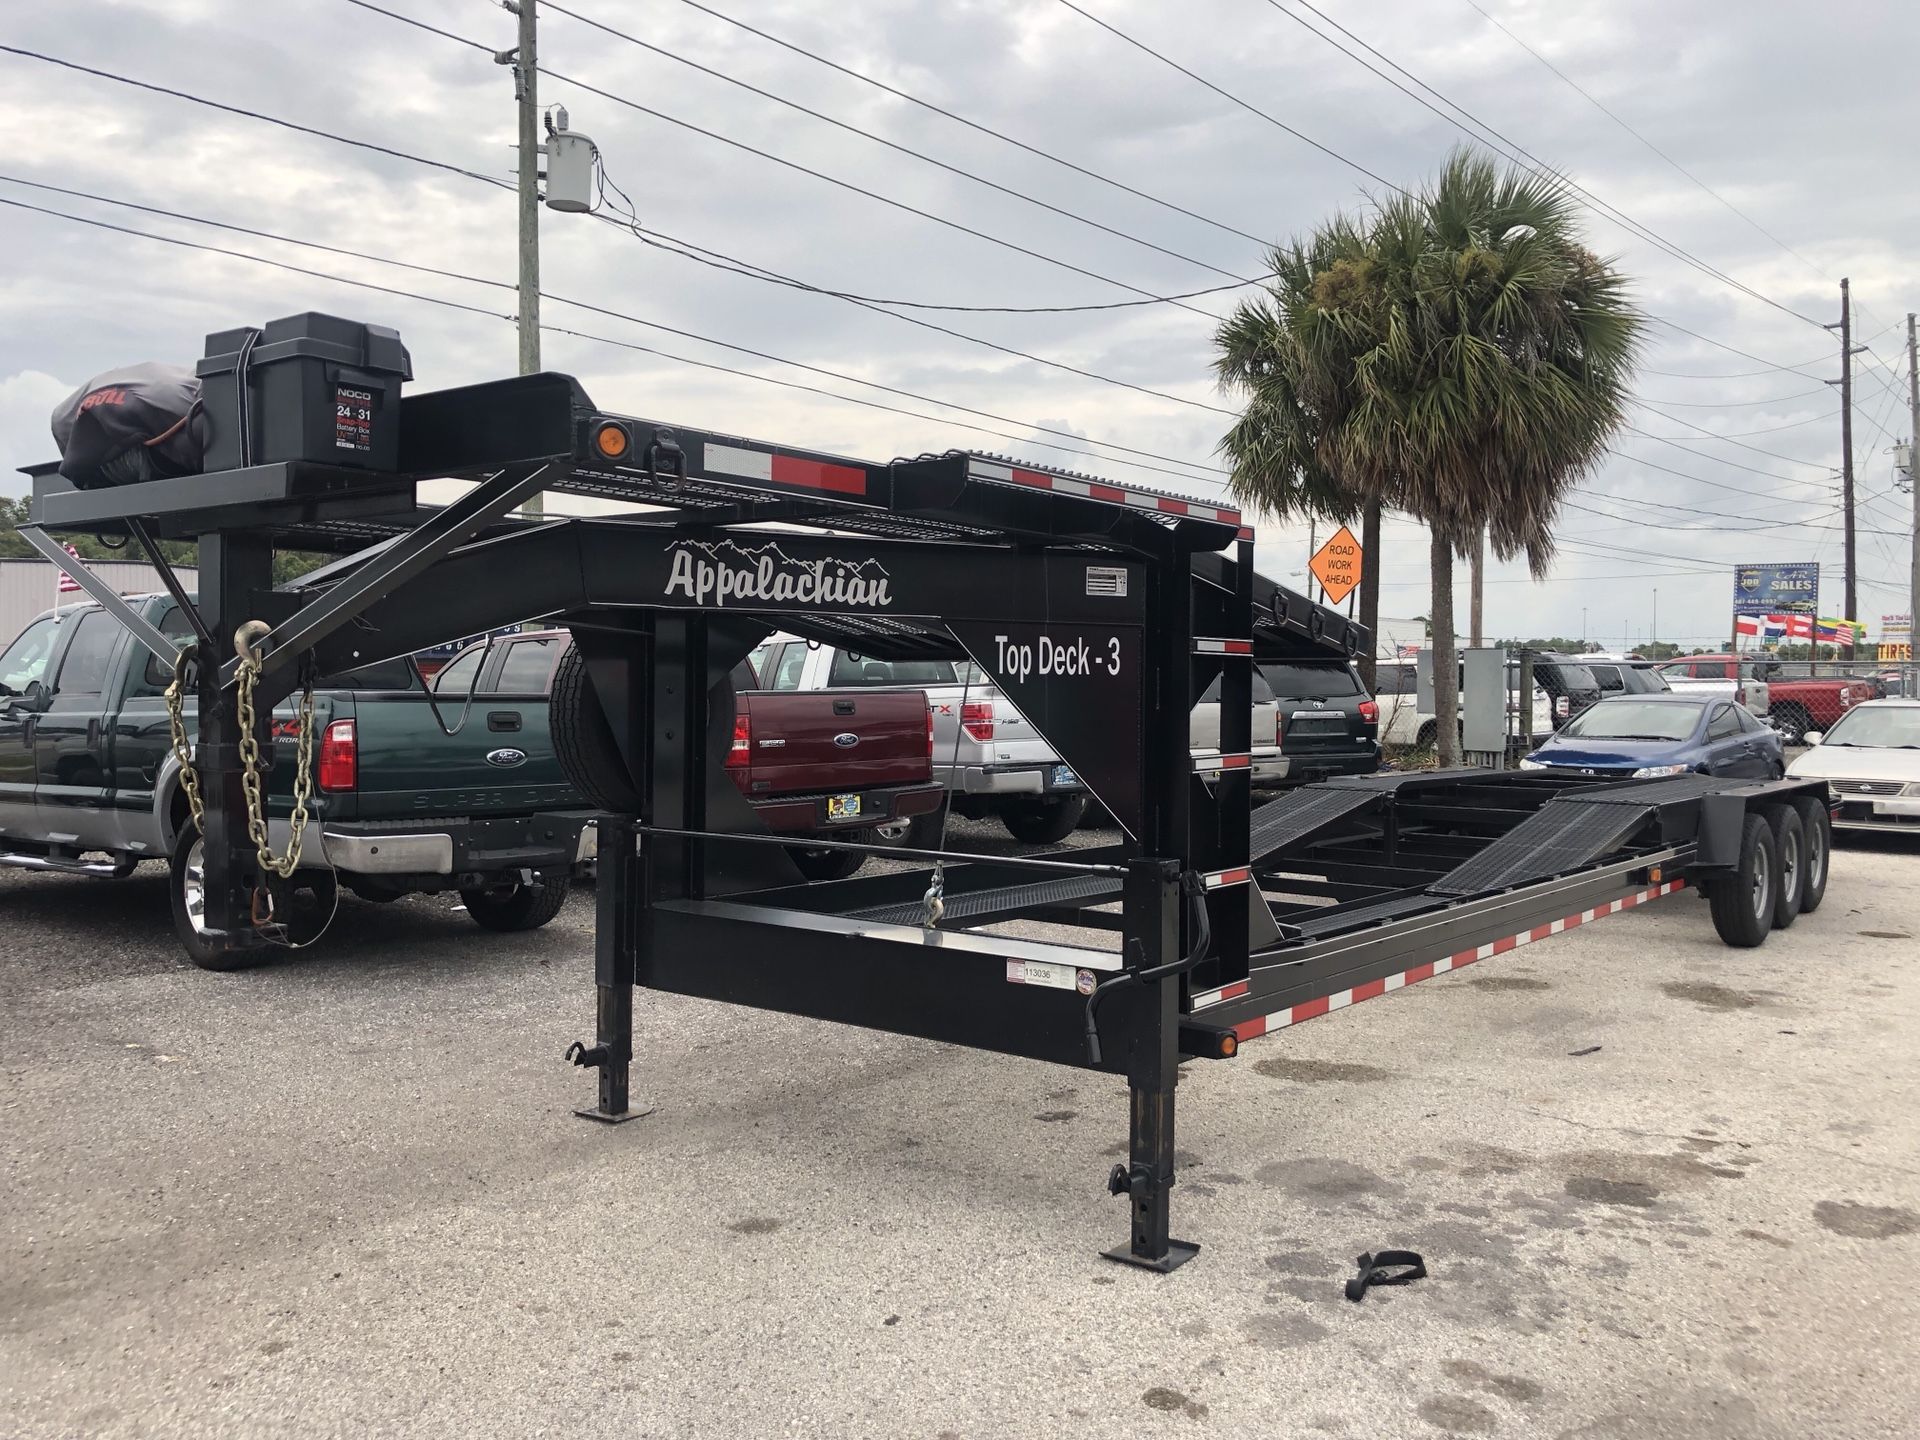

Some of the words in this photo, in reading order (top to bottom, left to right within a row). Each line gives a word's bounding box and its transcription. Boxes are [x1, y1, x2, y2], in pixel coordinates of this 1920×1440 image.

[337, 388, 371, 400] NOCO
[337, 406, 351, 417] 24
[358, 409, 371, 420] 31
[337, 424, 357, 433] Battery
[1329, 545, 1355, 556] ROAD
[1328, 560, 1353, 570] WORK
[664, 550, 893, 607] Appalachian
[1325, 574, 1353, 585] AHEAD
[1771, 580, 1813, 591] SALES
[1878, 644, 1912, 660] TIRES
[995, 635, 1032, 684] Top
[1039, 636, 1090, 675] Deck
[1107, 637, 1120, 675] 3
[413, 792, 505, 809] SUPER
[522, 789, 584, 803] DUT
[1025, 968, 1051, 979] 113036
